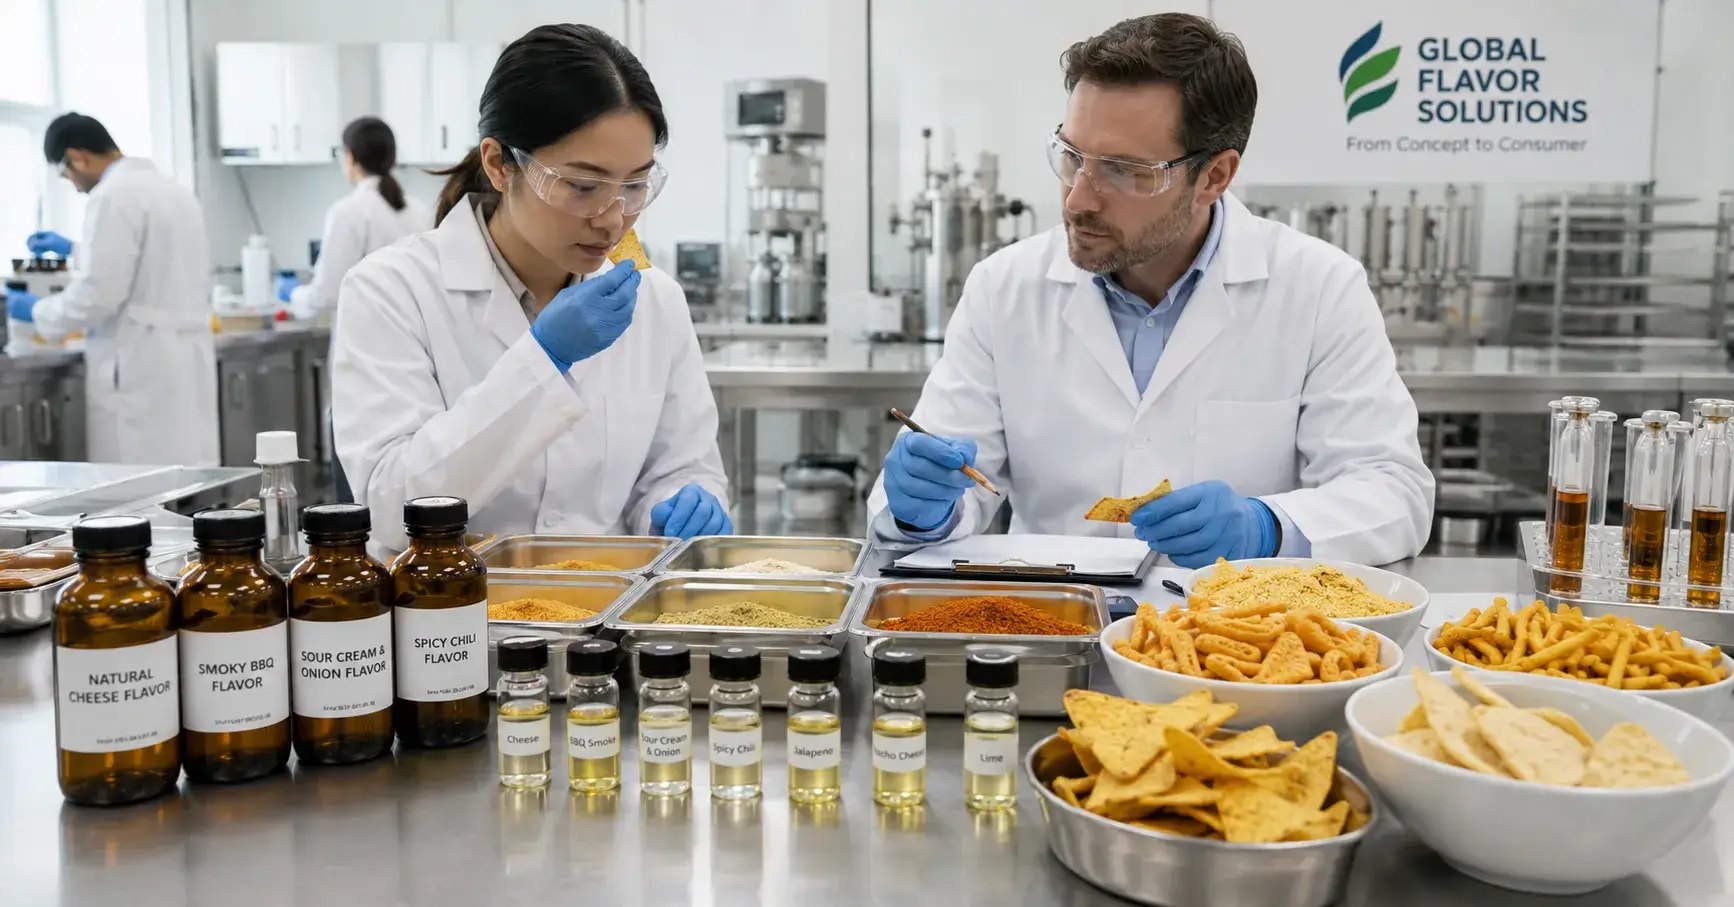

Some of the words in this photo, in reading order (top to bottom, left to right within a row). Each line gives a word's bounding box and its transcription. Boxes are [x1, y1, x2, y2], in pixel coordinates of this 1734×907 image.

[1418, 37, 1546, 62] GLOBAL
[1418, 69, 1540, 92] FLAVOR
[1417, 100, 1588, 123] SOLUTIONS
[1346, 137, 1391, 152] From
[1397, 136, 1469, 155] Concept
[1476, 138, 1493, 152] to
[1498, 136, 1587, 152] Consumer
[414, 637, 447, 648] SPICY
[450, 633, 476, 646] CHILI
[301, 650, 332, 663] SOUR
[336, 647, 377, 662] CREAM
[379, 645, 385, 655] &
[424, 650, 468, 664] FLAVOR
[198, 662, 246, 675] SMOKY
[250, 657, 274, 671] BBQ
[301, 667, 341, 679] ONION
[345, 661, 386, 678] FLAVOR
[88, 668, 154, 686] NATURAL
[212, 677, 263, 692] FLAVOR
[69, 691, 120, 704] CHEESE
[124, 680, 171, 701] FLAVOR
[507, 735, 540, 744] Cheese
[646, 747, 653, 756] &
[654, 748, 681, 756] Onion
[713, 743, 735, 755] Spicy
[737, 743, 756, 754] Chili
[980, 753, 1004, 763] Lime
